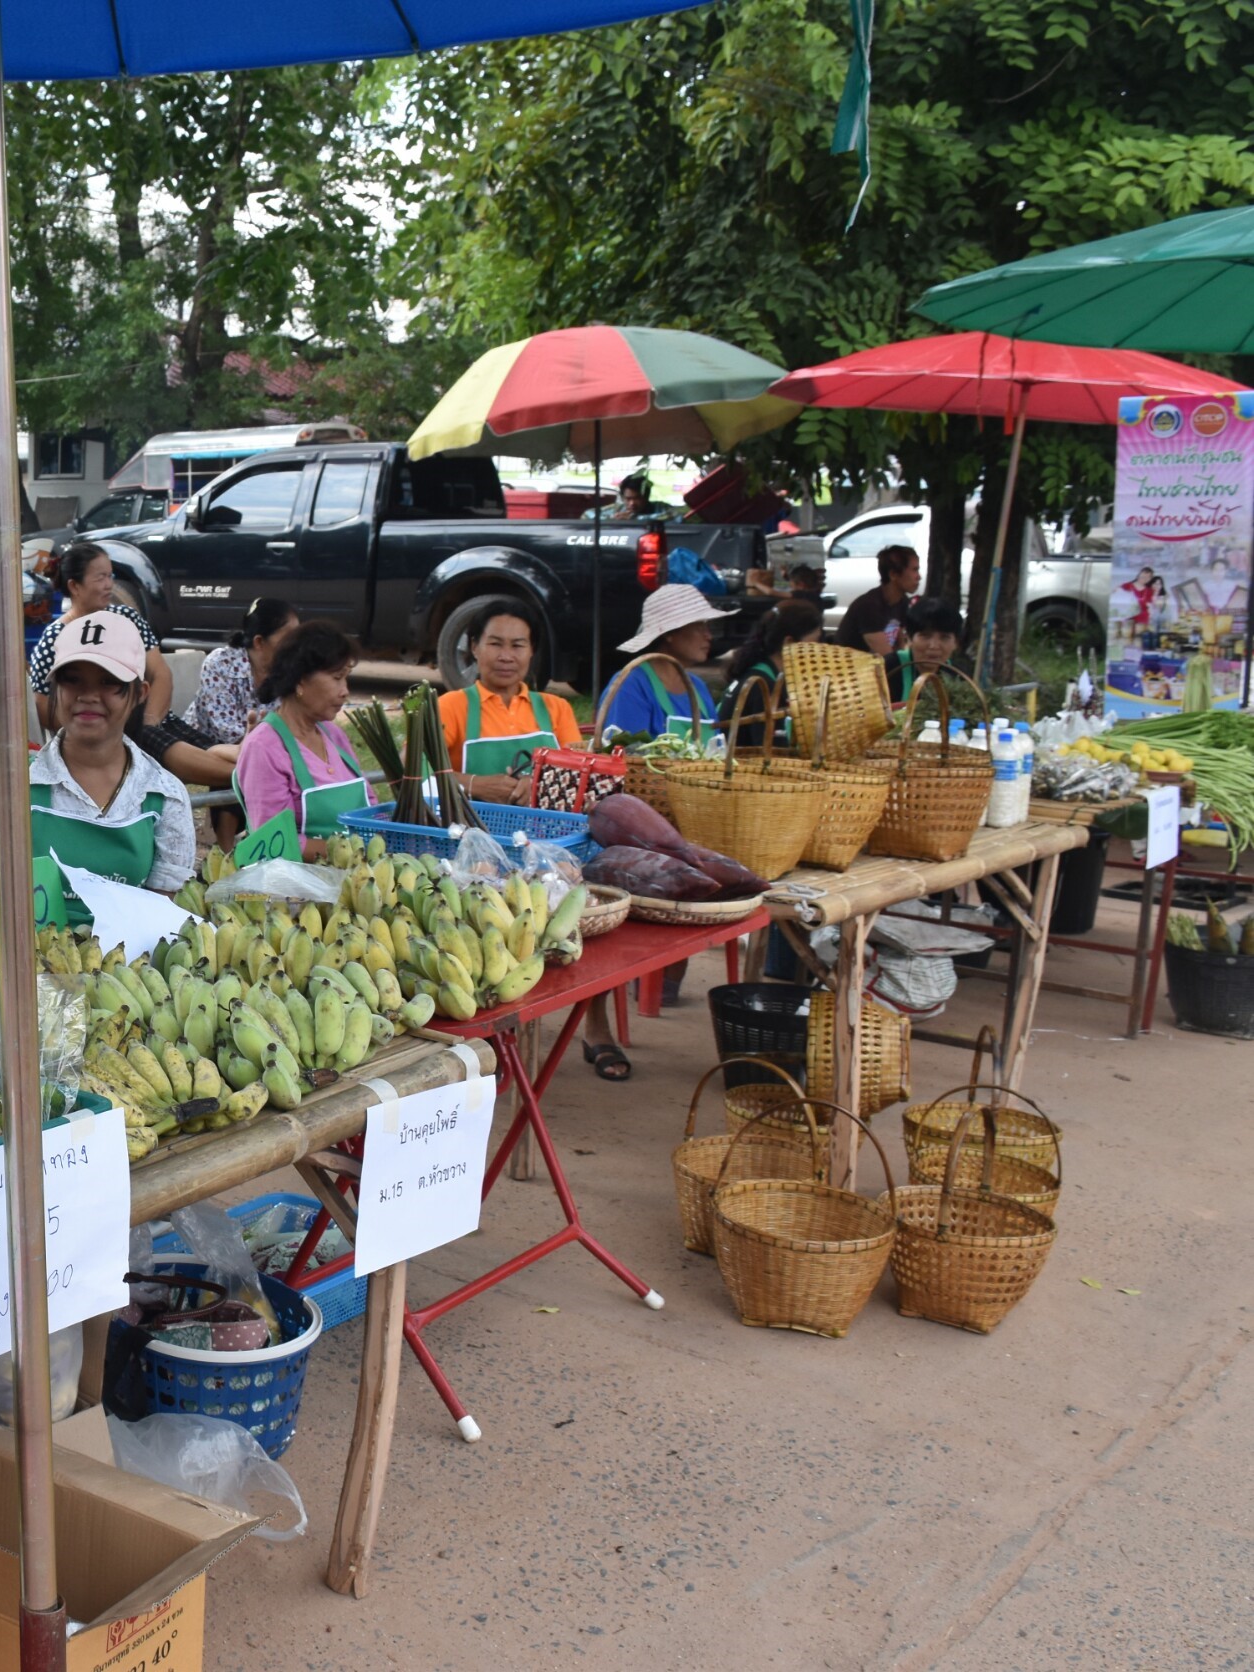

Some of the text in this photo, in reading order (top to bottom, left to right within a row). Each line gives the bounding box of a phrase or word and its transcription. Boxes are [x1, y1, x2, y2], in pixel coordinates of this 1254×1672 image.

[1128, 475, 1239, 497] ไทยช่วยไทย
[566, 535, 629, 546] CALBRE
[400, 1103, 461, 1144] บ้านคุยโพธิ์
[379, 1162, 466, 1203] ม.15 ต.หัวขวาง
